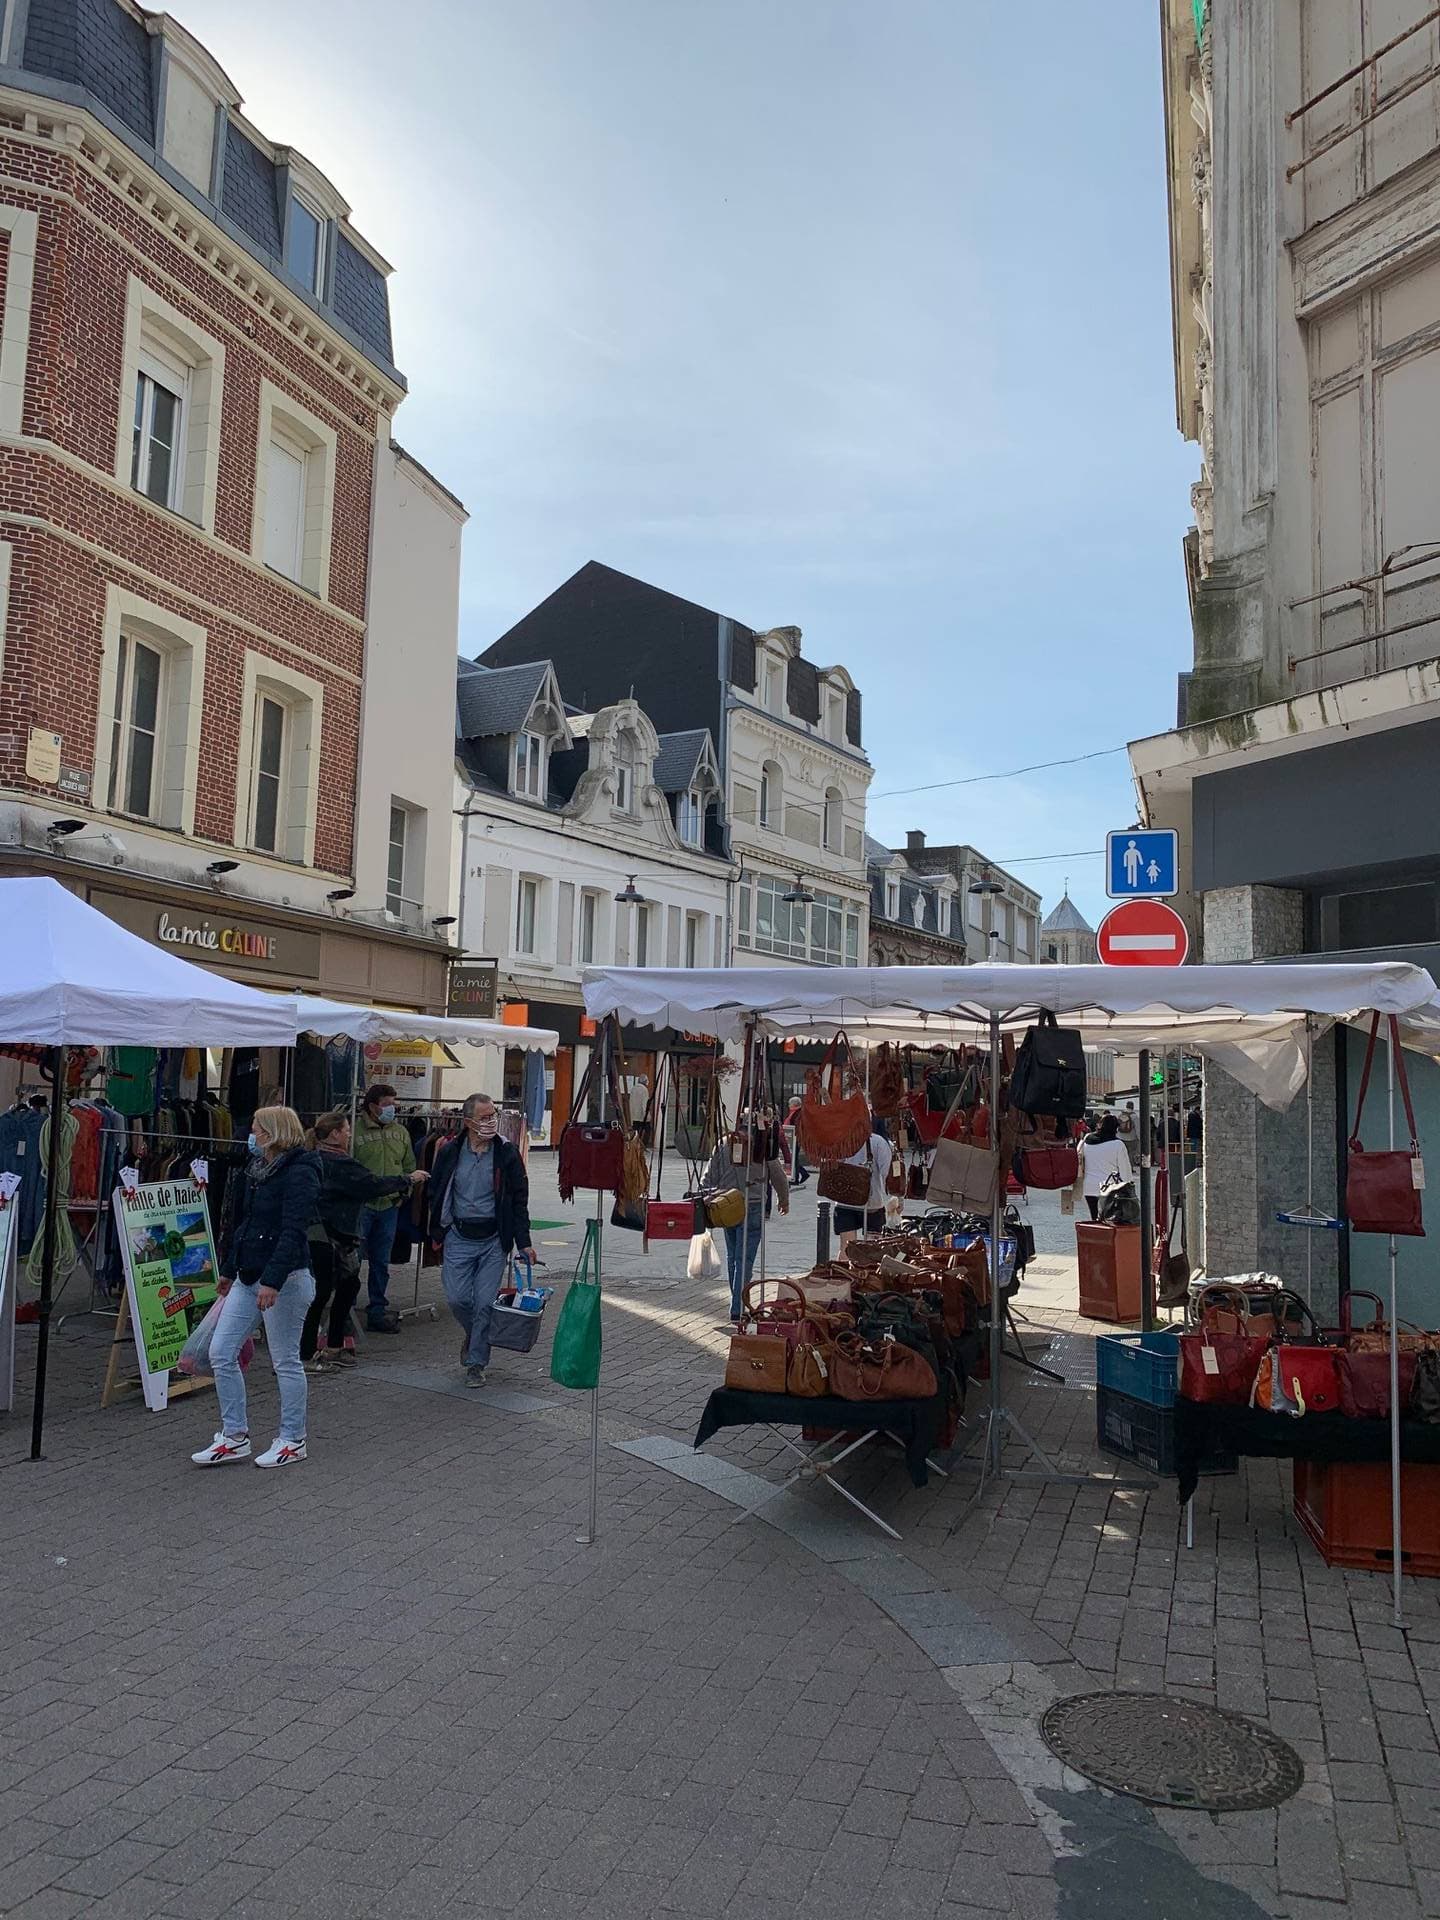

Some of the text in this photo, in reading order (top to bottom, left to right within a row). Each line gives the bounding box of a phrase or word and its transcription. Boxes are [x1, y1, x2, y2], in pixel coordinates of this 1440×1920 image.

[69, 771, 80, 781] RUE
[158, 912, 180, 942] la
[180, 922, 219, 950] mie
[453, 974, 491, 988] la mie
[157, 1187, 172, 1208] de
[174, 1185, 202, 1206] haies
